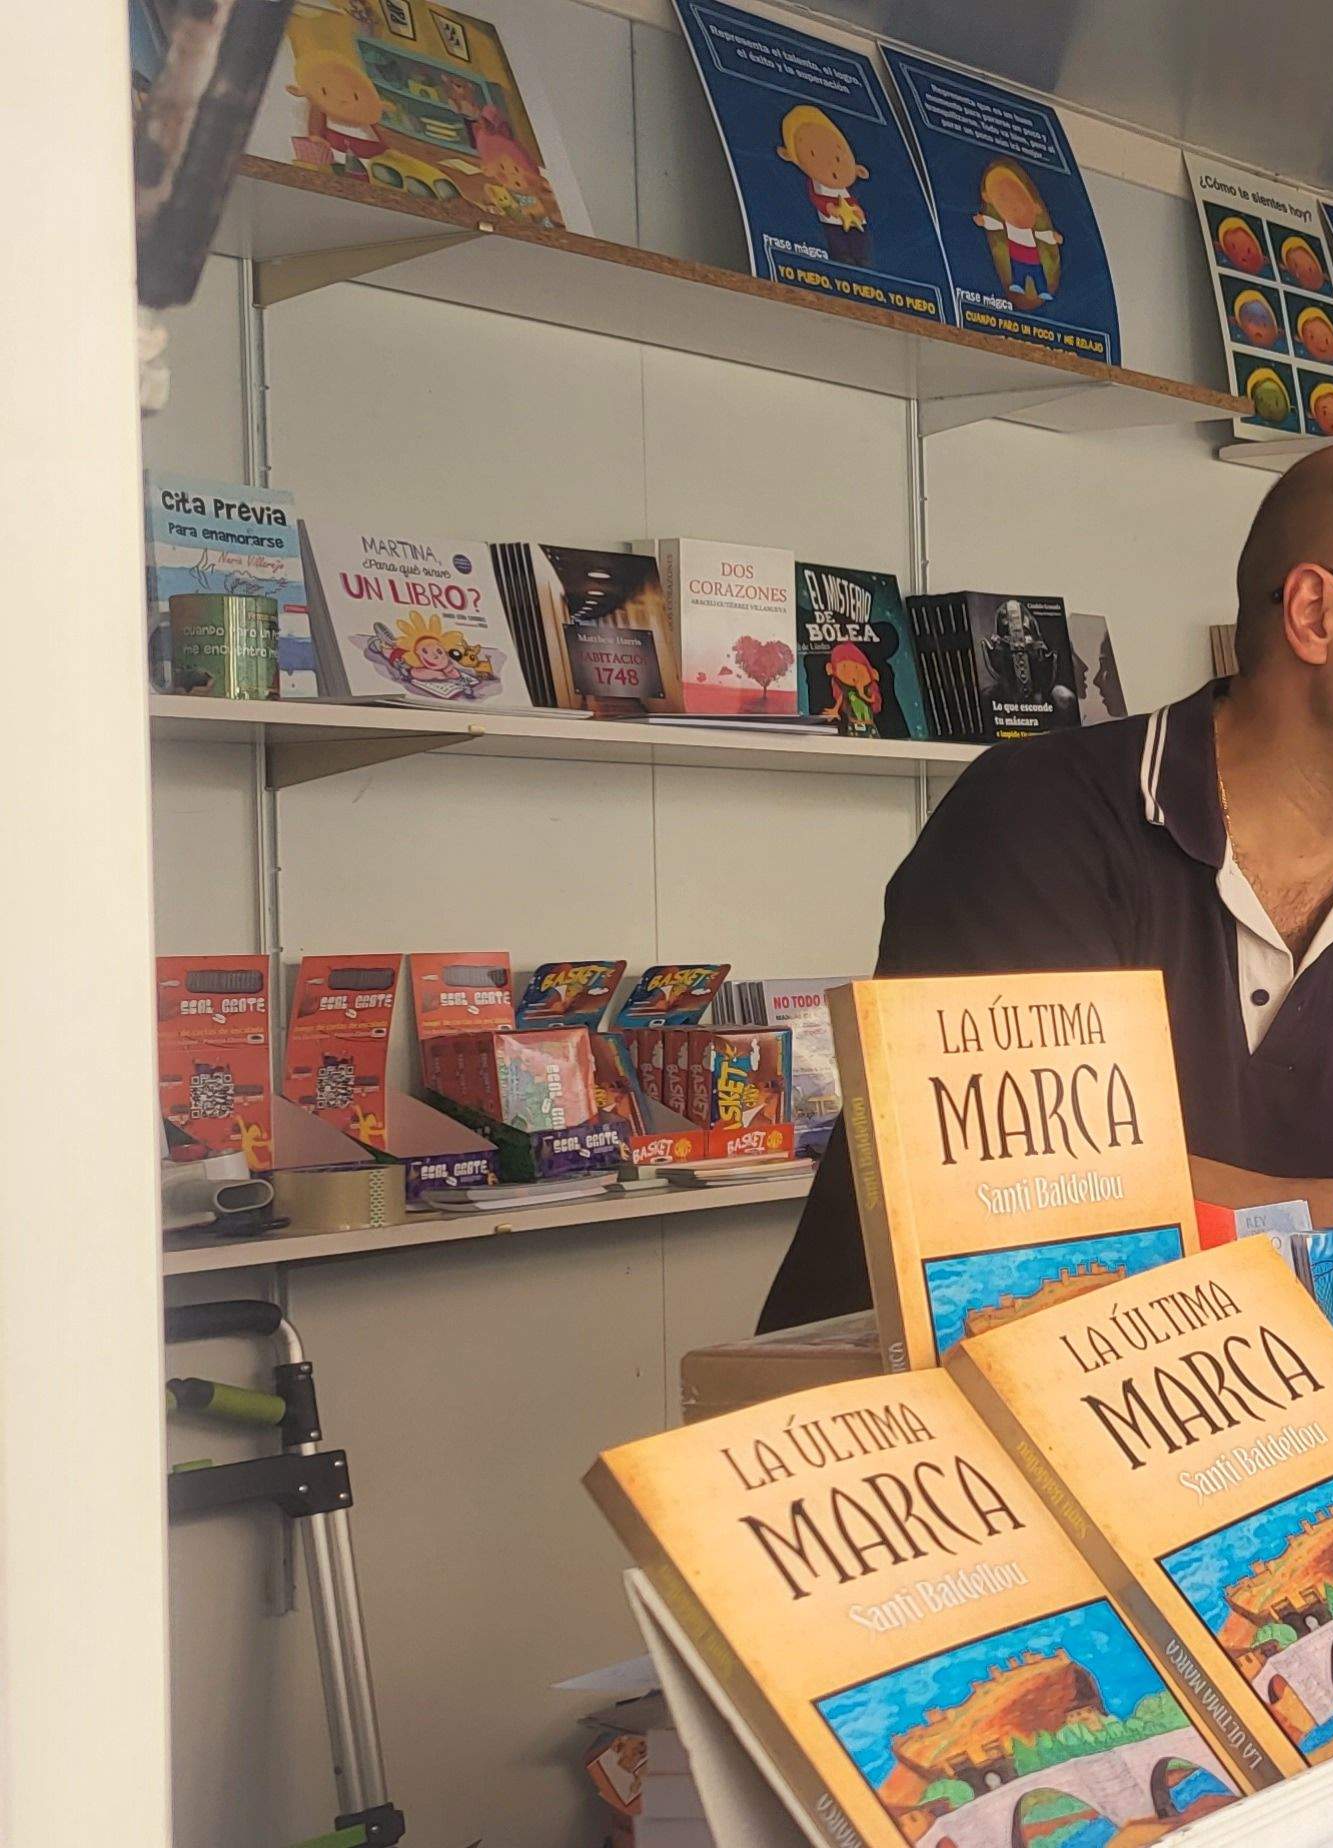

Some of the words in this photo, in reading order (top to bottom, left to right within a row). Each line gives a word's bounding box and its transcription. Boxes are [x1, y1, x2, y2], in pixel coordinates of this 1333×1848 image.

[1199, 175, 1237, 197] ¿Cómo
[1239, 188, 1250, 202] te
[1250, 192, 1288, 212] sientes
[778, 265, 795, 280] YO
[834, 278, 850, 293] YO
[888, 292, 904, 306] YO
[906, 296, 936, 315] PUEDO
[966, 310, 997, 327] CUANDO
[998, 319, 1019, 332] PARO
[1021, 324, 1031, 336] UN
[1033, 326, 1054, 340] POCO
[202, 528, 285, 548] enamorarse
[689, 579, 788, 603] CORAZONES
[720, 562, 754, 579] DOS
[339, 572, 384, 600] UN
[388, 579, 482, 613] LIBRO?
[804, 569, 825, 610] EL
[821, 573, 872, 623] MISTERIO
[805, 623, 881, 642] BOLEA
[814, 611, 836, 623] DE
[594, 667, 640, 686] 1748
[992, 700, 1003, 711] Lo
[773, 996, 790, 1009] NO
[791, 995, 821, 1008] TODO
[937, 1008, 984, 1055] LA
[988, 994, 1107, 1052] ÚLTIMA
[718, 1060, 748, 1130] SKET
[929, 1062, 1144, 1166] MARCA
[633, 1139, 674, 1163] BASKET
[727, 1132, 766, 1155] BASKET
[977, 1176, 1031, 1216] Santi
[1036, 1170, 1125, 1212] Baldellou
[1246, 1216, 1267, 1228] REY
[1059, 1330, 1122, 1373] LA
[1110, 1280, 1242, 1351] ÚLTIMA
[1081, 1325, 1325, 1470] MARCA
[719, 1438, 794, 1490] LA
[783, 1402, 936, 1464] ÚLTIMA
[1178, 1456, 1240, 1507] Santi
[1236, 1418, 1330, 1477] Baldellou
[738, 1454, 1026, 1600] MARCA
[848, 1594, 918, 1643] Santi
[913, 1557, 1030, 1620] Baldellou
[1164, 1636, 1206, 1697] MARCA
